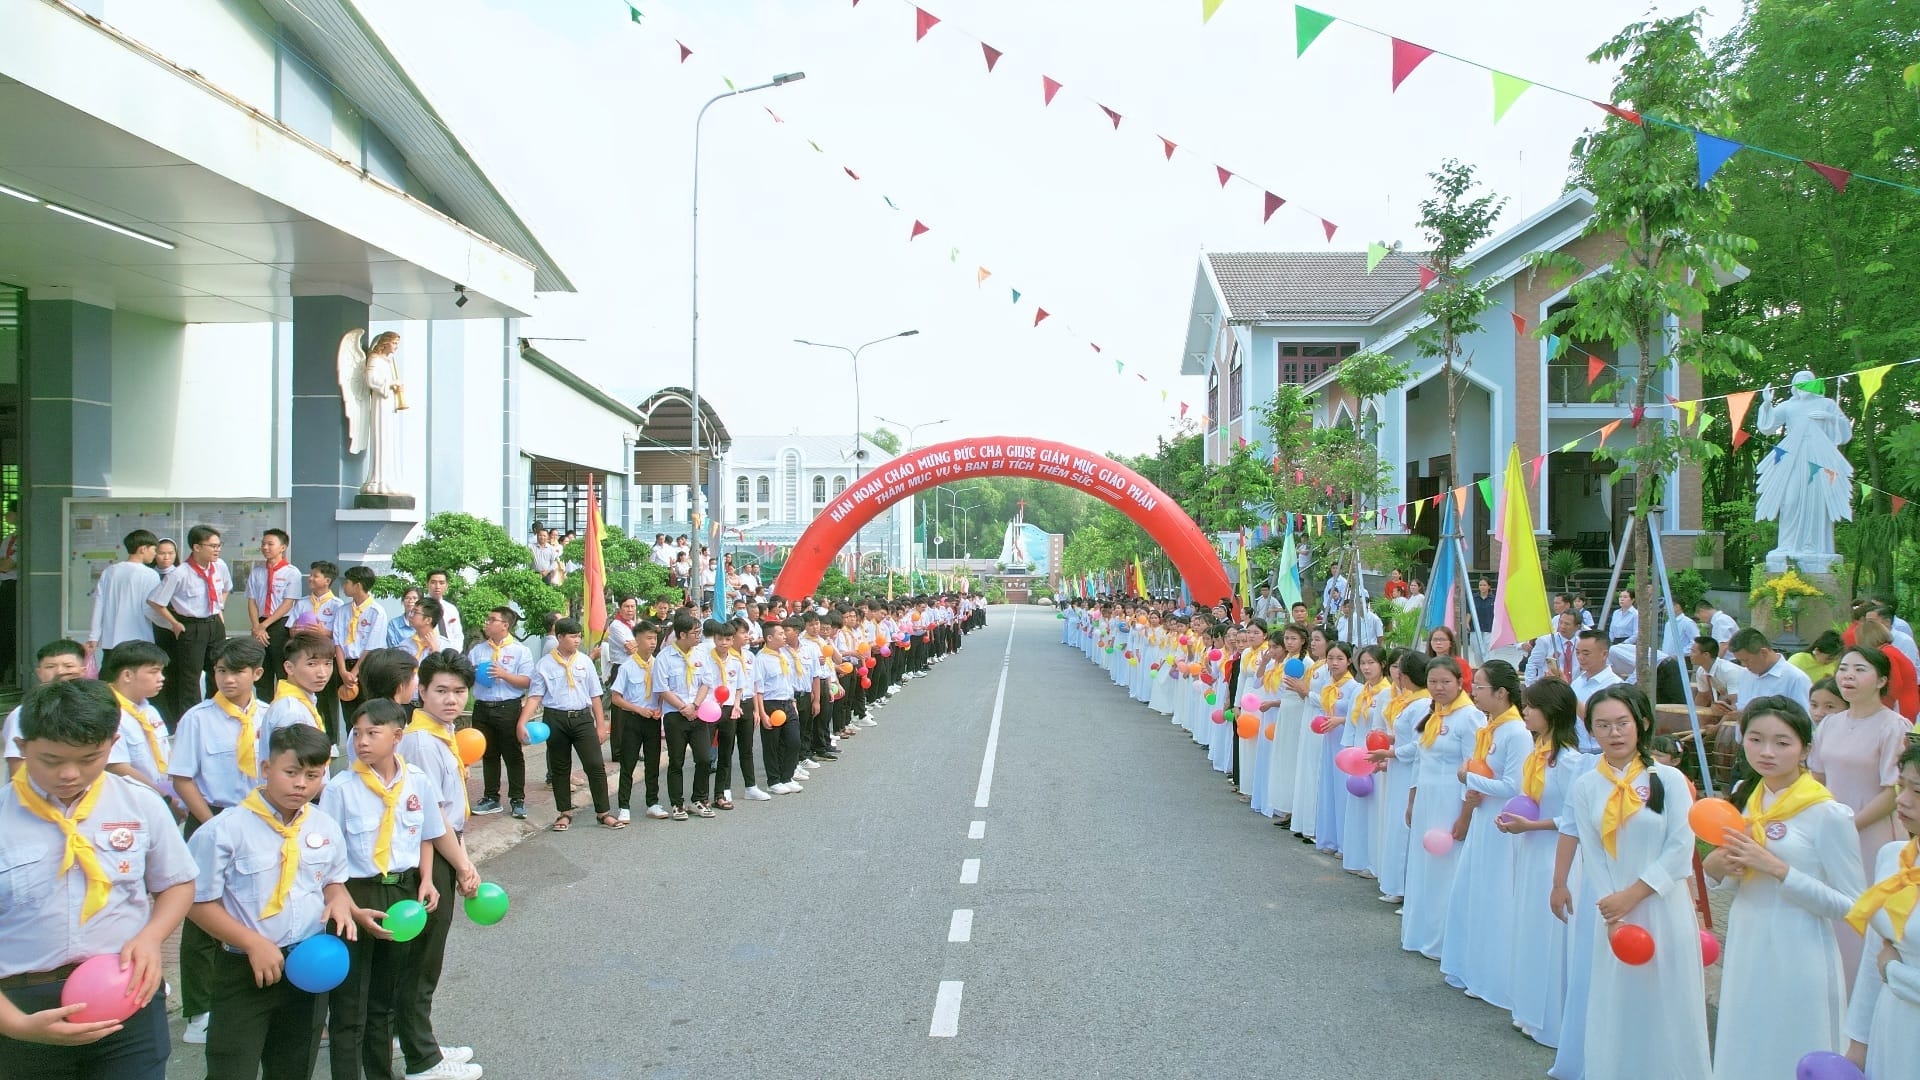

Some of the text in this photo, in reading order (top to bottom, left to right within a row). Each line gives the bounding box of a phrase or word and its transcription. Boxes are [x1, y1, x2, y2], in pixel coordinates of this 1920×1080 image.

[830, 498, 855, 523] HÂN
[852, 477, 884, 504] HOAN
[953, 445, 977, 460] ĐỨC
[979, 445, 1003, 458] CHA
[1006, 445, 1037, 459] GIUSE
[1040, 448, 1071, 467] GIÁM
[1072, 457, 1098, 475] MỤC
[1098, 468, 1126, 490] GIÁO
[875, 485, 906, 504] THĂM
[907, 471, 932, 488] MỤC
[935, 465, 951, 476] VỤ
[964, 461, 989, 472] BAN
[991, 458, 1006, 469] BÍ
[1008, 459, 1035, 470] TÍCH
[1038, 463, 1070, 478] THÊM
[1070, 472, 1094, 487] SỨC
